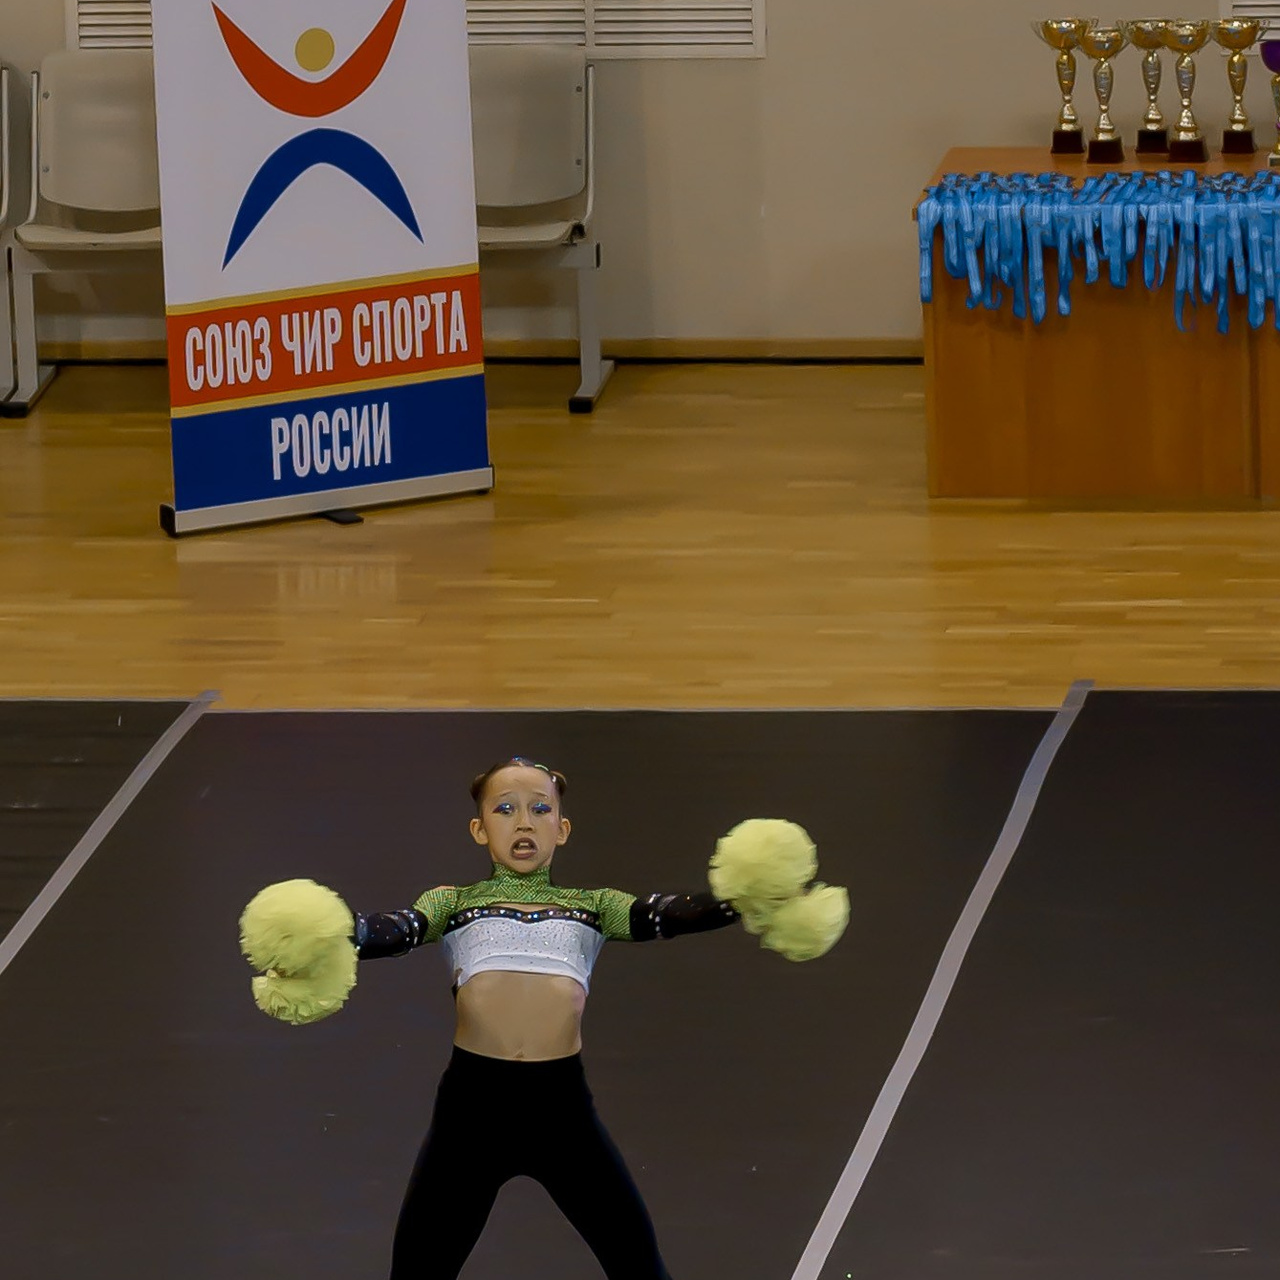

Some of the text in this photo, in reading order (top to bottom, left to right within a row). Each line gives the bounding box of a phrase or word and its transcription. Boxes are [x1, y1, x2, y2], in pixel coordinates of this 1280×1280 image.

[186, 290, 468, 390] СОЮЗ ЧИР СПОРТА
[271, 402, 391, 480] РОССИИ
